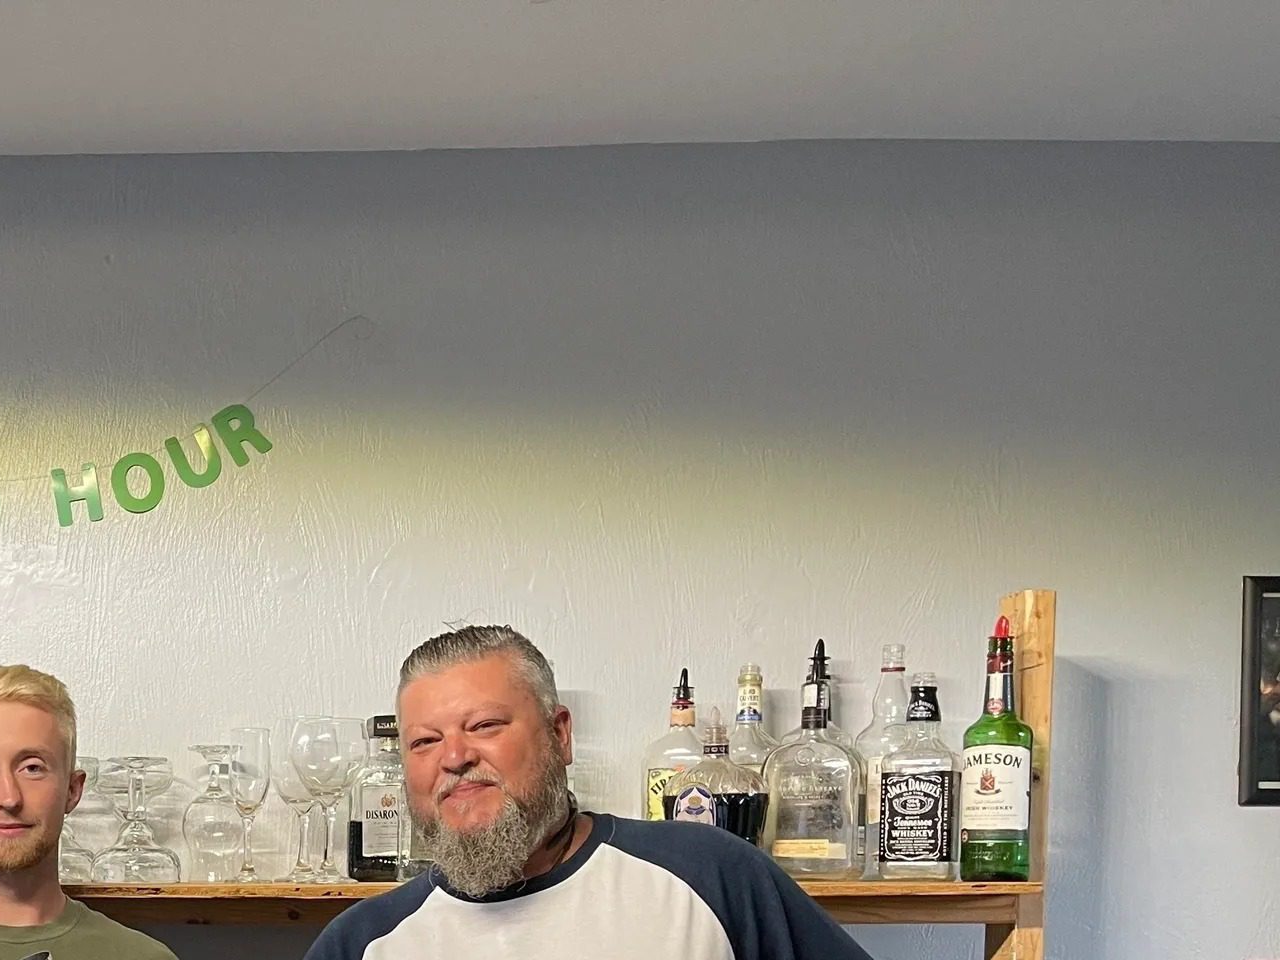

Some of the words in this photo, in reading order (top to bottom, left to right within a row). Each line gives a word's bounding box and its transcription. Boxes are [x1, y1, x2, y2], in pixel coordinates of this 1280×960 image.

[51, 403, 274, 528] HOUR
[886, 781, 907, 798] JACK
[891, 829, 934, 838] WHISKEY
